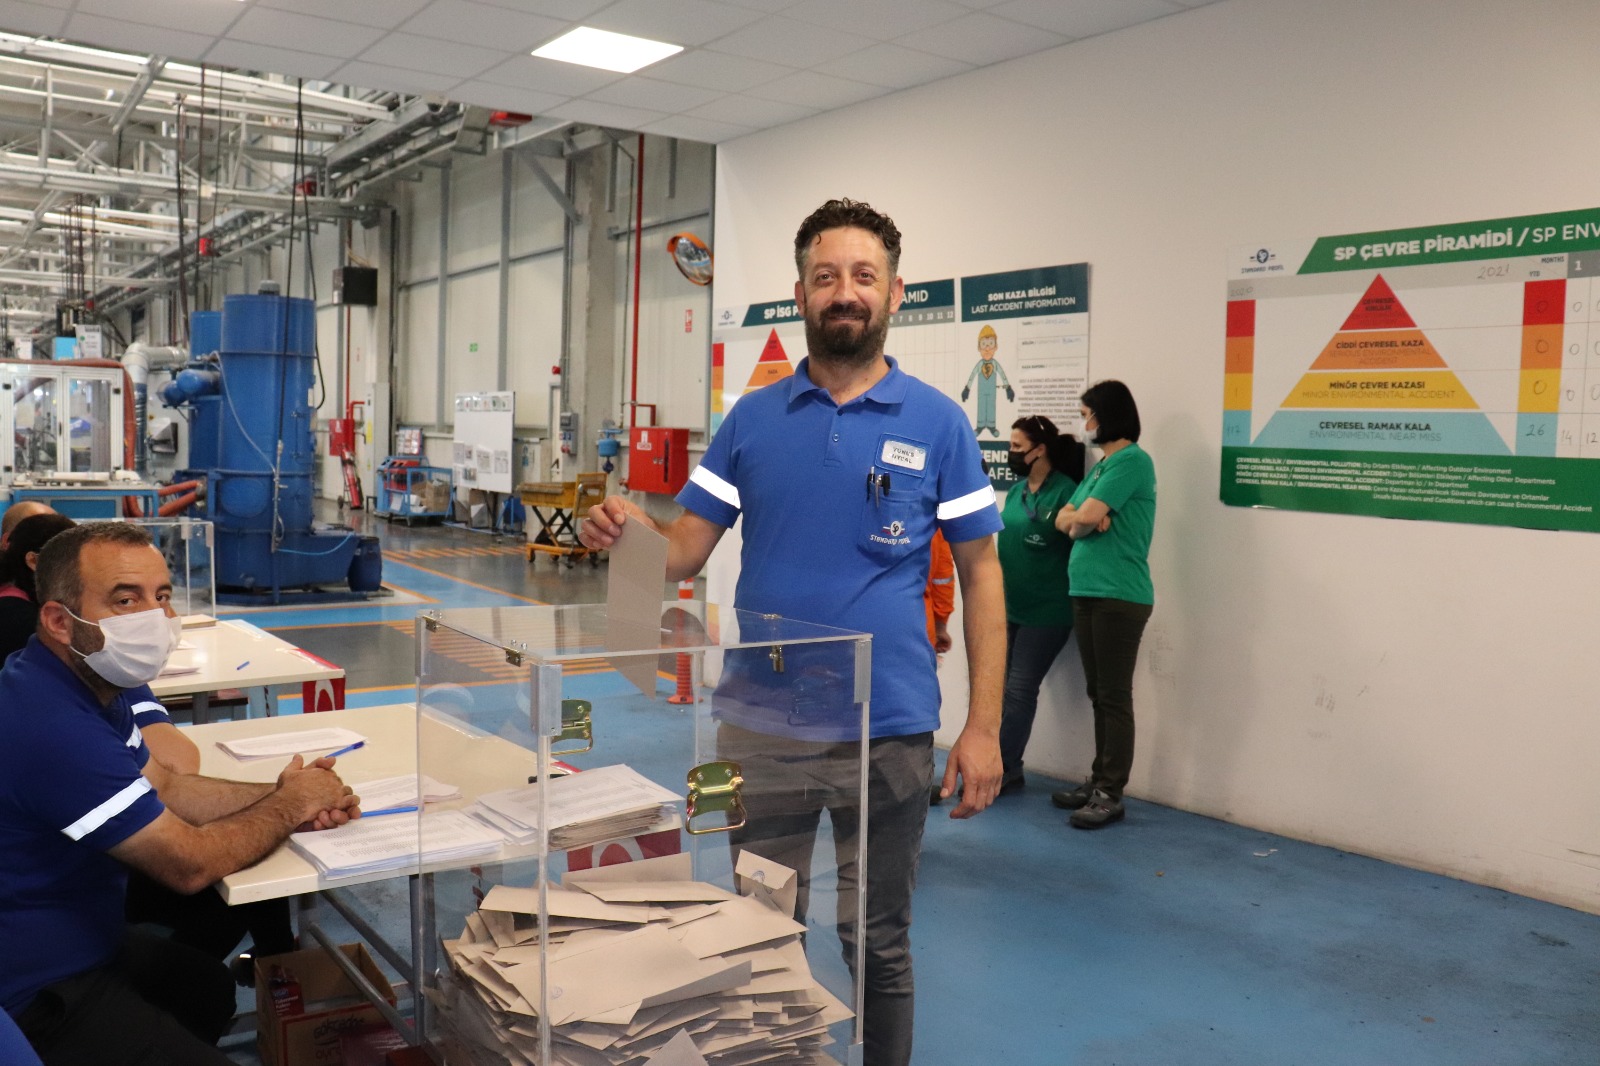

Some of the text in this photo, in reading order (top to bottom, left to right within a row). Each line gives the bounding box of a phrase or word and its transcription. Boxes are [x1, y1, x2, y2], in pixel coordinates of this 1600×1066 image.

[1334, 247, 1356, 261] SP
[1360, 240, 1421, 261] ÇEVRE
[1425, 227, 1513, 252] PİRAMİDİ
[1517, 227, 1529, 247] /
[1532, 227, 1556, 243] SP
[1540, 256, 1565, 264] MONTHS
[1574, 260, 1582, 271] 1
[1477, 264, 1510, 280] 2021
[988, 286, 1056, 302] SON KAZA BİLGİSİ
[971, 297, 1076, 314] LAST ACCIDENT INFORMATION
[764, 308, 776, 320] SP
[777, 305, 792, 318] İSG
[1336, 341, 1357, 349] CİDDİ
[1358, 340, 1399, 349] ÇEVRESEL
[1330, 381, 1425, 390] MİNÖR ÇEVRE KAZASI
[1533, 380, 1548, 395] 0
[1302, 390, 1455, 398] MINOR ENVIRONMENTAL ACCIDENT
[1319, 421, 1432, 431] ÇEVRESEL RAMAK KALA
[1526, 424, 1546, 437] 26
[1309, 431, 1442, 442] ENVIRONMENTAL NEAR MISS
[1586, 432, 1598, 444] 12
[981, 450, 1009, 464] END
[1515, 476, 1556, 485] Departments
[1516, 501, 1562, 510] Environmental
[1562, 504, 1592, 512] Accident
